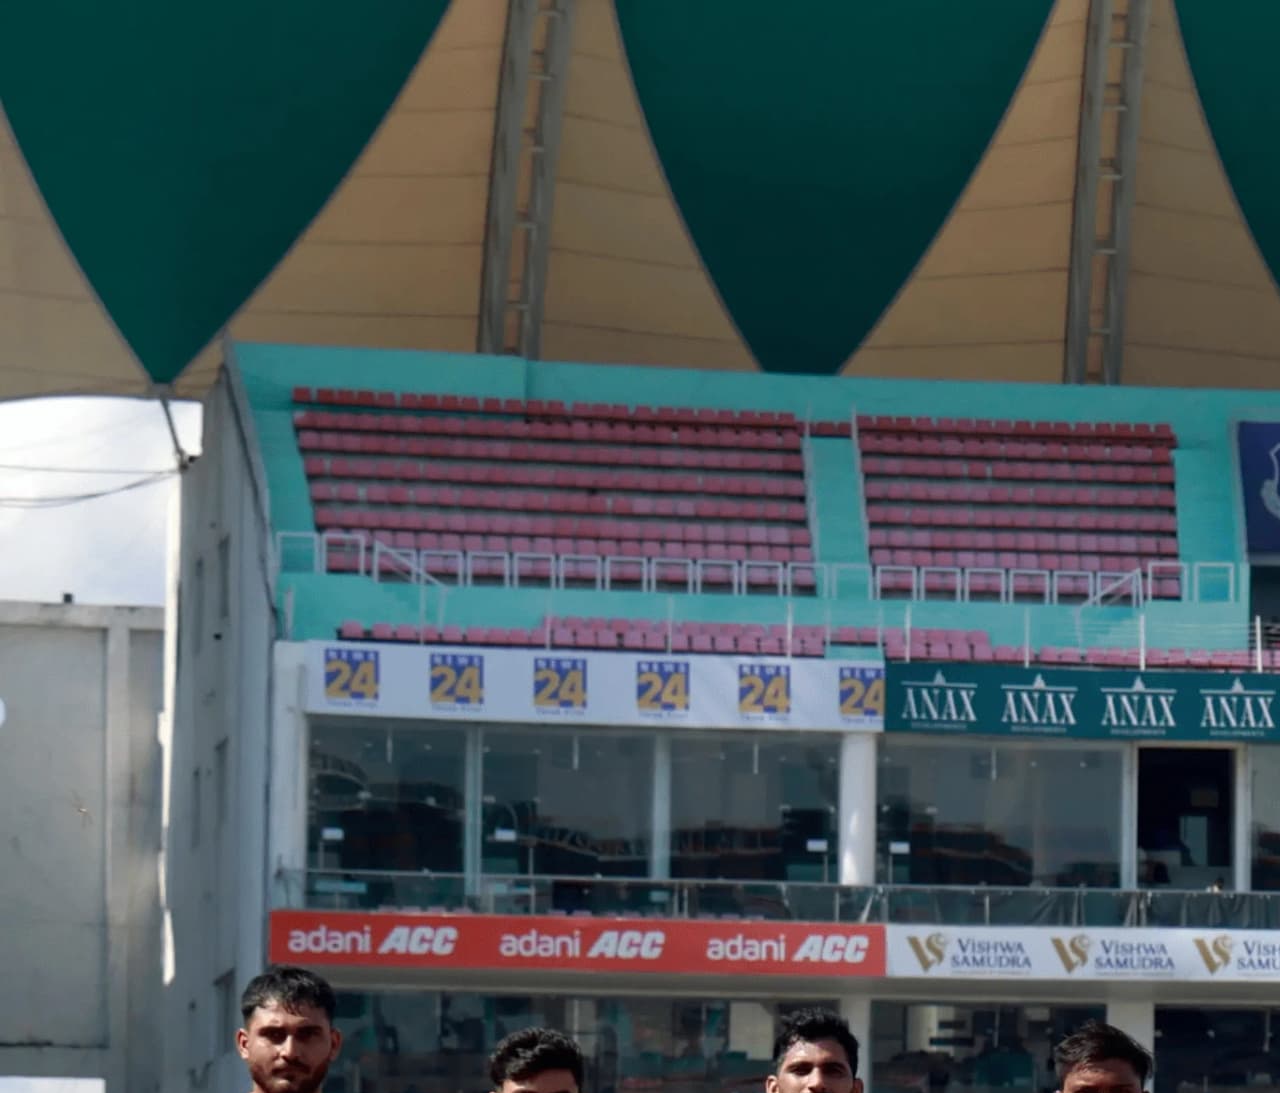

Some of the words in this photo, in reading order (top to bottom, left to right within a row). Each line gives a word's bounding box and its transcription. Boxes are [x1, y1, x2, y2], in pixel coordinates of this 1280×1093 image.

[325, 661, 378, 700] 24
[431, 666, 483, 704] 24
[534, 670, 587, 708] 24
[637, 673, 689, 711] 24
[739, 676, 791, 713] 24
[902, 688, 977, 721] ANAX
[1002, 691, 1077, 725] ANAX
[1101, 695, 1176, 727] ANAX
[1200, 696, 1276, 728] ANAX
[288, 925, 371, 953] adani
[378, 926, 458, 955] ACC
[500, 929, 581, 957] adani
[587, 930, 665, 960] ACC
[706, 934, 786, 961] adani
[792, 935, 869, 963] ACC
[951, 955, 1032, 969] SAMUDRA
[1095, 957, 1175, 970] SAMUDRA
